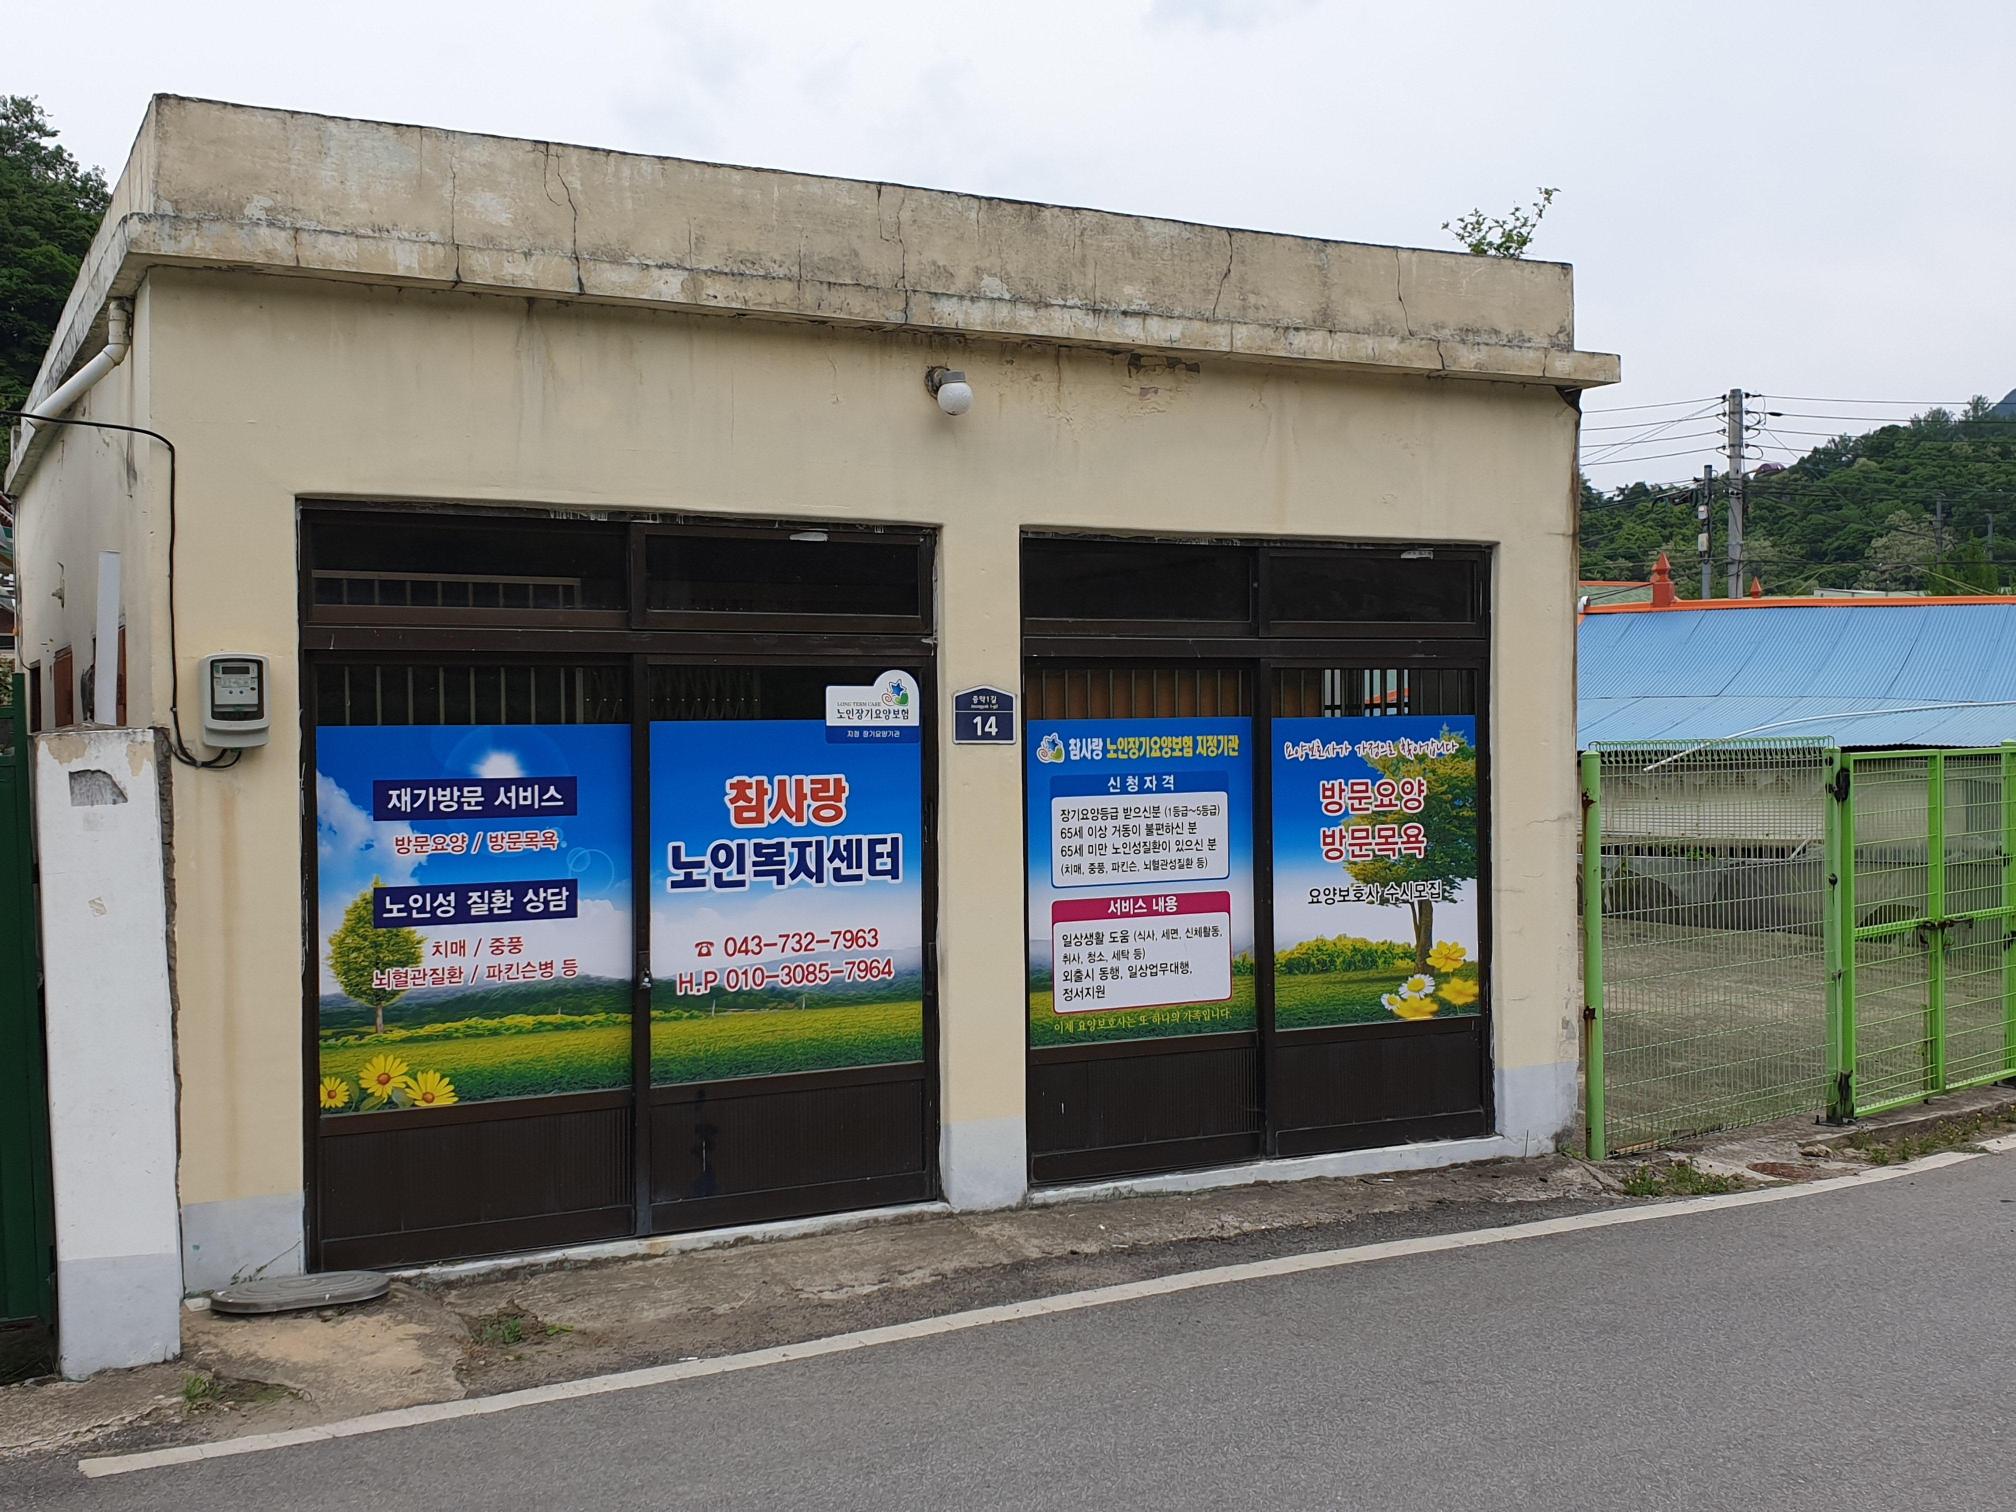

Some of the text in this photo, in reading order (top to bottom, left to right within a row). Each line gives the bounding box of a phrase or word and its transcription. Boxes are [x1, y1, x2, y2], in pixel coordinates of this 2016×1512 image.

[837, 708, 909, 720] 노인장기요양보험
[973, 716, 998, 736] 14
[1069, 735, 1239, 761] 참사랑 노인장기요양보험 지정기관
[1285, 737, 1460, 761] 요양보호사가 가정으로 찾아갑니다
[388, 784, 565, 813] 재가방문 서비스
[727, 775, 847, 825] 참사랑
[1320, 777, 1427, 815] 방문요양
[1060, 804, 1221, 822] 장기요양등급 받으신분 (1등급~5등급)
[1060, 821, 1197, 840] 65세 이상 거동이 불편하신 분
[1320, 823, 1427, 861] 방문목욕
[394, 830, 559, 855] 방문요양 / 방문목욕
[1061, 837, 1217, 857] 65세 미만 노인성질환이 있으신 분
[668, 835, 902, 890] 노인복지센터
[1061, 857, 1208, 876] (치매, 중풍, 파킨슨, 뇌혈관성질환 등)
[383, 886, 569, 920] 노인성 질환 상담
[1308, 880, 1443, 905] 요양보호사 수시모집
[1107, 895, 1178, 914] 서비스 내용
[432, 936, 524, 959] 치매 / 중풍
[723, 928, 879, 958] 043-732-7963
[1062, 925, 1223, 948] 일상생활 도움 (식사, 세면, 신체활동,
[1062, 948, 1145, 965] 취사, 청소, 세탁 등)
[373, 959, 578, 990] 뇌혈관질환 / 파킨슨병 등
[677, 958, 894, 995] H.P 010-3085-7964
[1063, 960, 1193, 983] 외출시 동행, 일상업무대행,
[1063, 985, 1106, 1002] 정서지원
[1054, 1020, 1073, 1034] 이제
[1078, 1016, 1136, 1032] 요양보호사는
[1139, 1015, 1148, 1026] 또
[1152, 1011, 1180, 1025] 하나의
